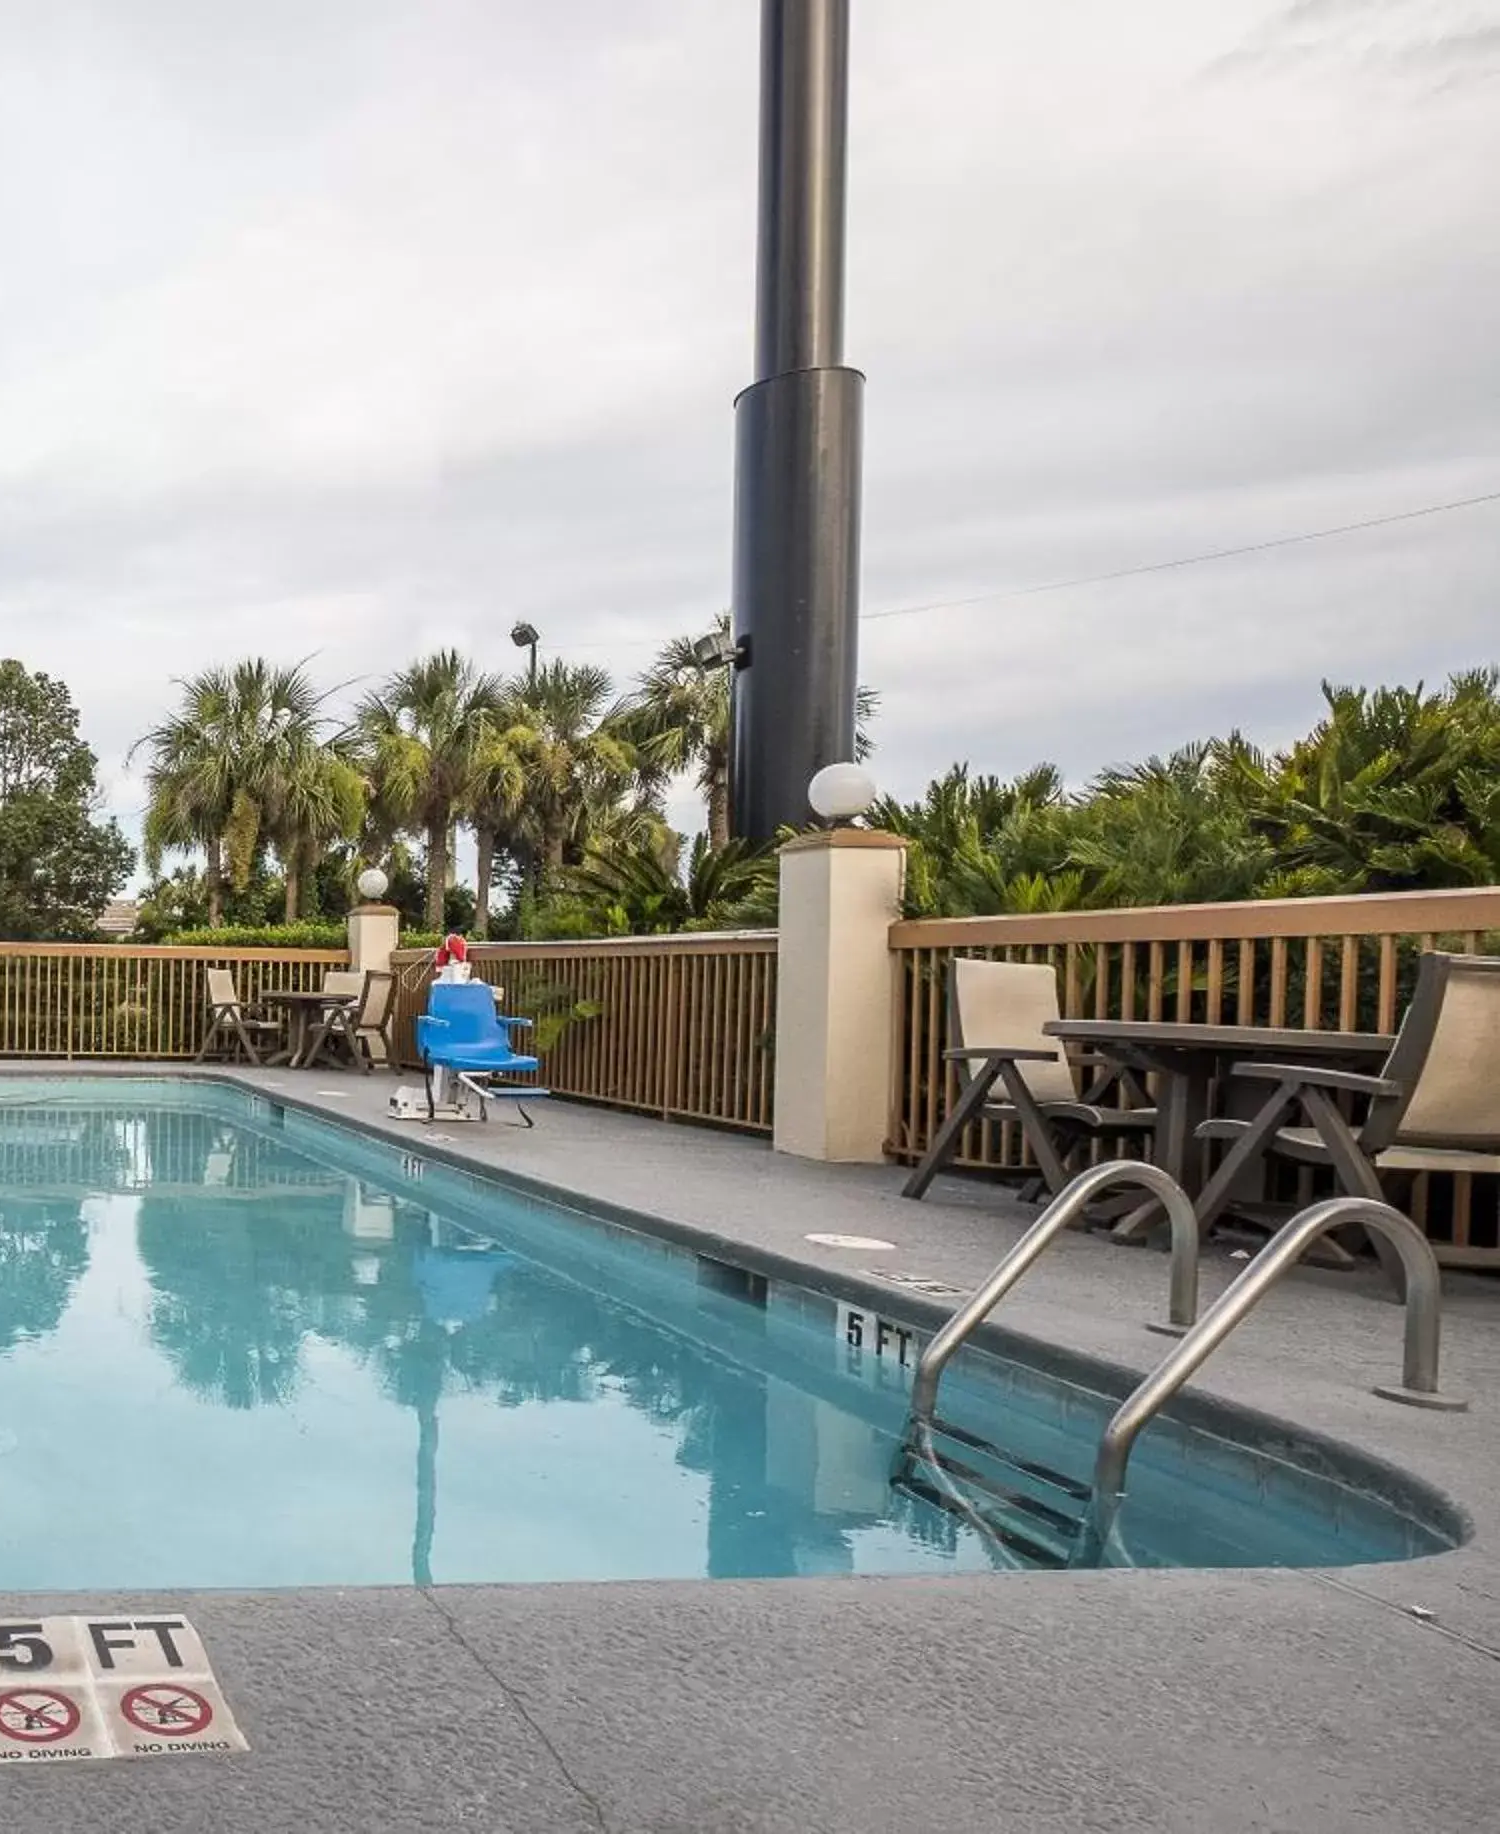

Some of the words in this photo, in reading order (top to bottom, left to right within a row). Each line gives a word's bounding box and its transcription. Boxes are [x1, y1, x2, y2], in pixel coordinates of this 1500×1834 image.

[847, 1311, 863, 1347] 5
[88, 1621, 184, 1668] FT
[28, 1747, 92, 1760] DIVING
[133, 1744, 161, 1754] NO
[167, 1741, 231, 1753] DIVING
